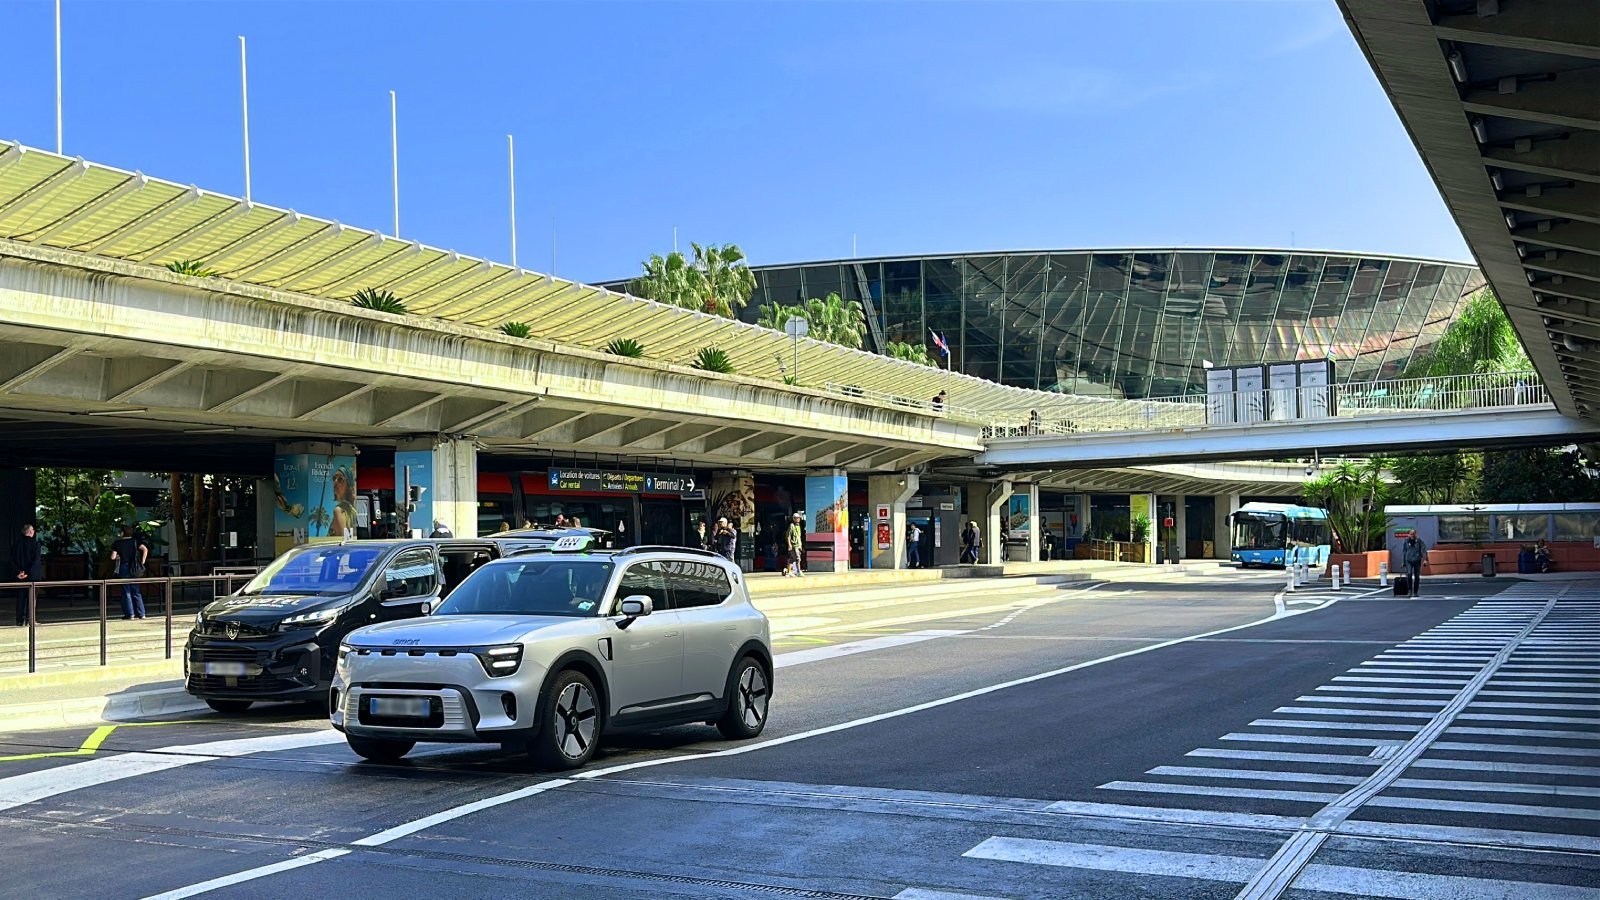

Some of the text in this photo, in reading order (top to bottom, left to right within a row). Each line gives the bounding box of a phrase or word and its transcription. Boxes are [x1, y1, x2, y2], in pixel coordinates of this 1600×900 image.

[314, 461, 334, 470] French
[311, 468, 330, 476] Riviera
[560, 470, 600, 480] Location de voitures
[607, 472, 621, 482] Départs
[624, 473, 644, 483] Departures
[560, 480, 580, 489] Car rental
[625, 483, 638, 491] Arrivals
[653, 477, 685, 491] Terminal 2
[392, 638, 421, 646] smart
